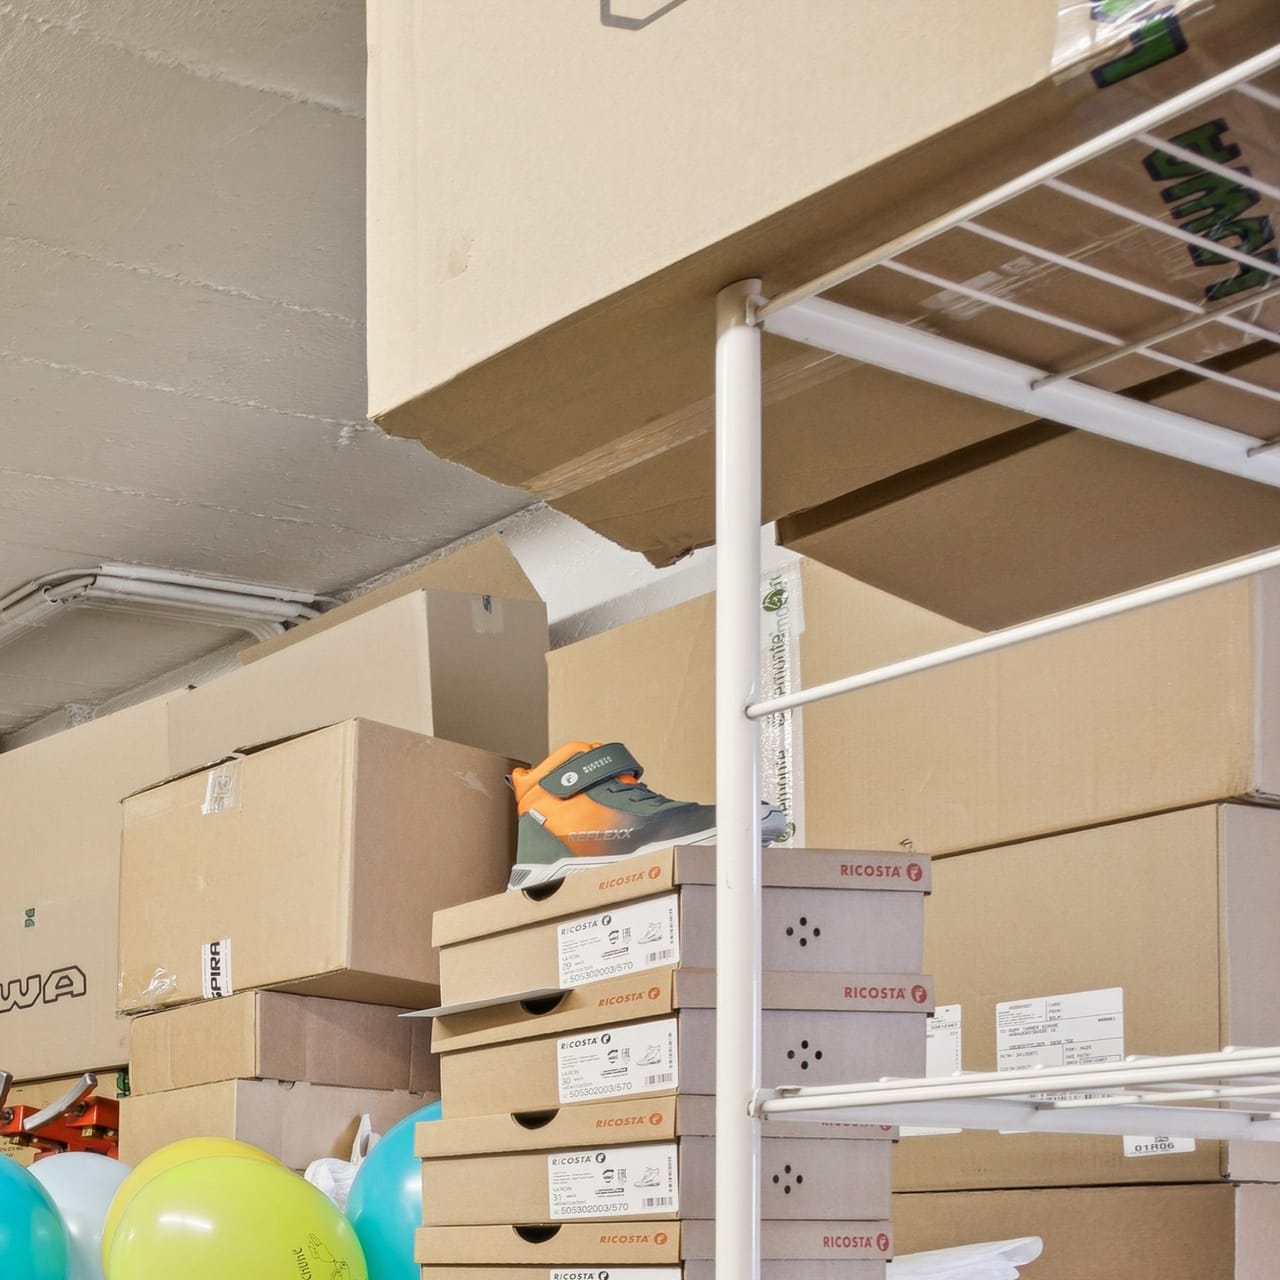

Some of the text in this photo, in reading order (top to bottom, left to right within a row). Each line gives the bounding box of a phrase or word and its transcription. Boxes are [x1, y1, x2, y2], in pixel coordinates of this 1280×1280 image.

[567, 827, 634, 842] REFLEXX
[840, 863, 900, 879] RICOSTA
[598, 872, 646, 891] RICOSTA
[561, 919, 598, 935] RICOSTA
[570, 961, 634, 983] 505302003/570
[598, 991, 646, 1007] RICOSTA
[844, 986, 906, 1000] RICOSTA
[560, 1037, 597, 1050] RICOSTA
[569, 1082, 632, 1099] 505302003/570
[595, 1114, 647, 1129] RICOSTA
[1133, 1140, 1175, 1153] 01R06
[552, 1156, 591, 1166] RICOSTA
[561, 1203, 629, 1215] 505302003/570
[599, 1234, 650, 1245] RICOSTA
[823, 1235, 873, 1249] RICOSTA
